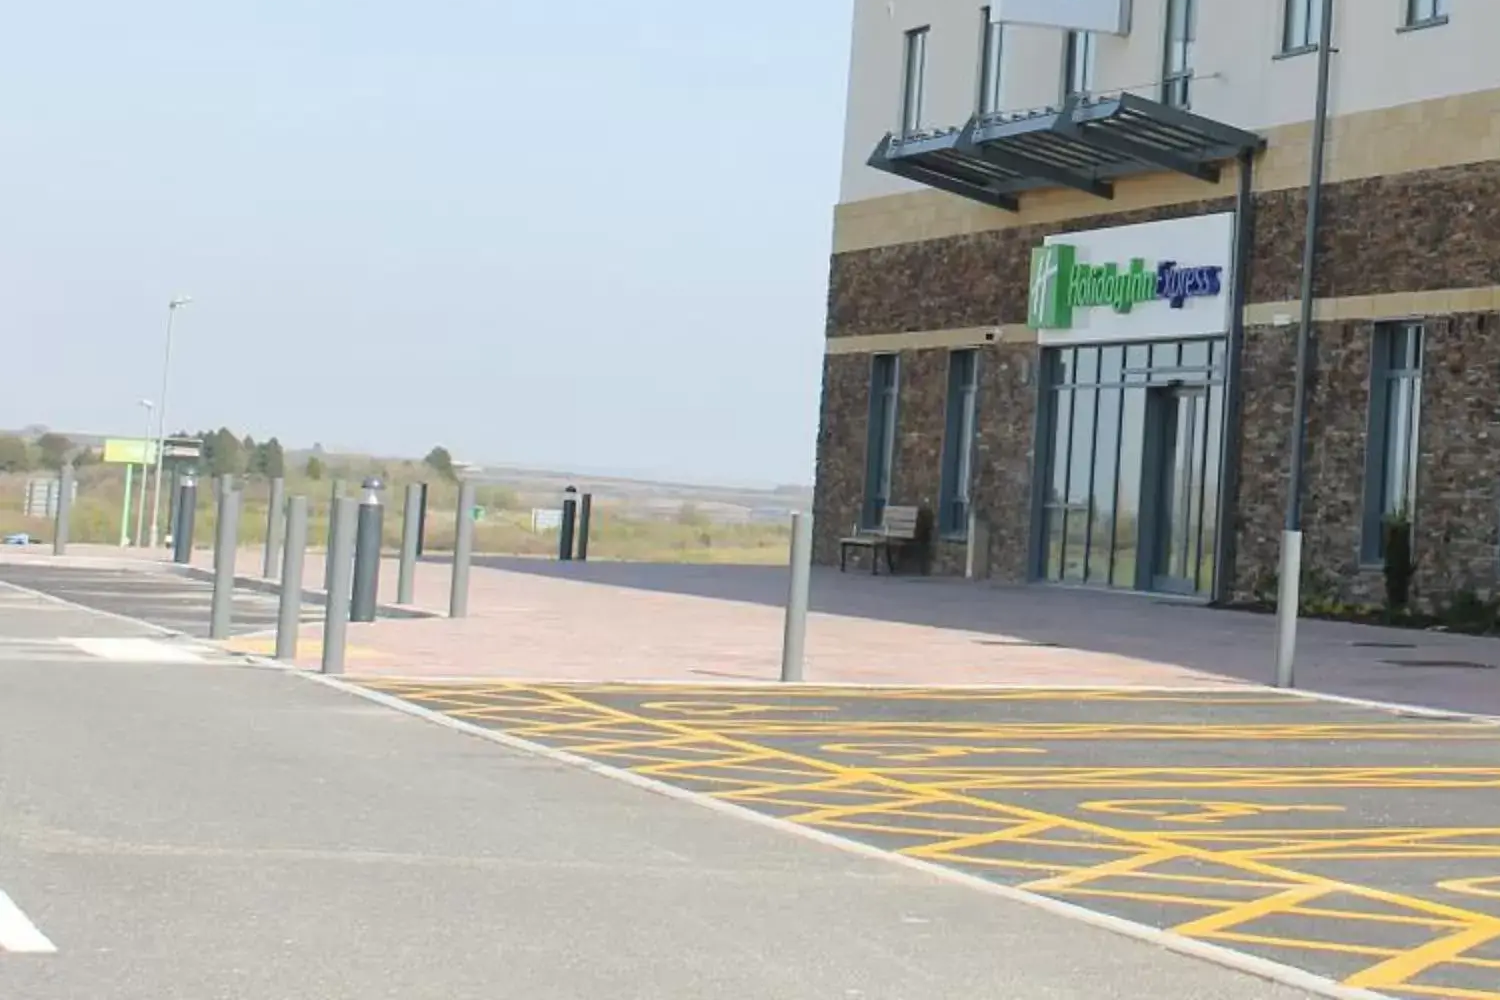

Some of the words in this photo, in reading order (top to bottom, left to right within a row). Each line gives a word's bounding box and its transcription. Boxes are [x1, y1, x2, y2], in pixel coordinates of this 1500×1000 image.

[1066, 262, 1132, 314] Holiday
[1127, 260, 1157, 303] Inn
[1156, 261, 1223, 309] Express
